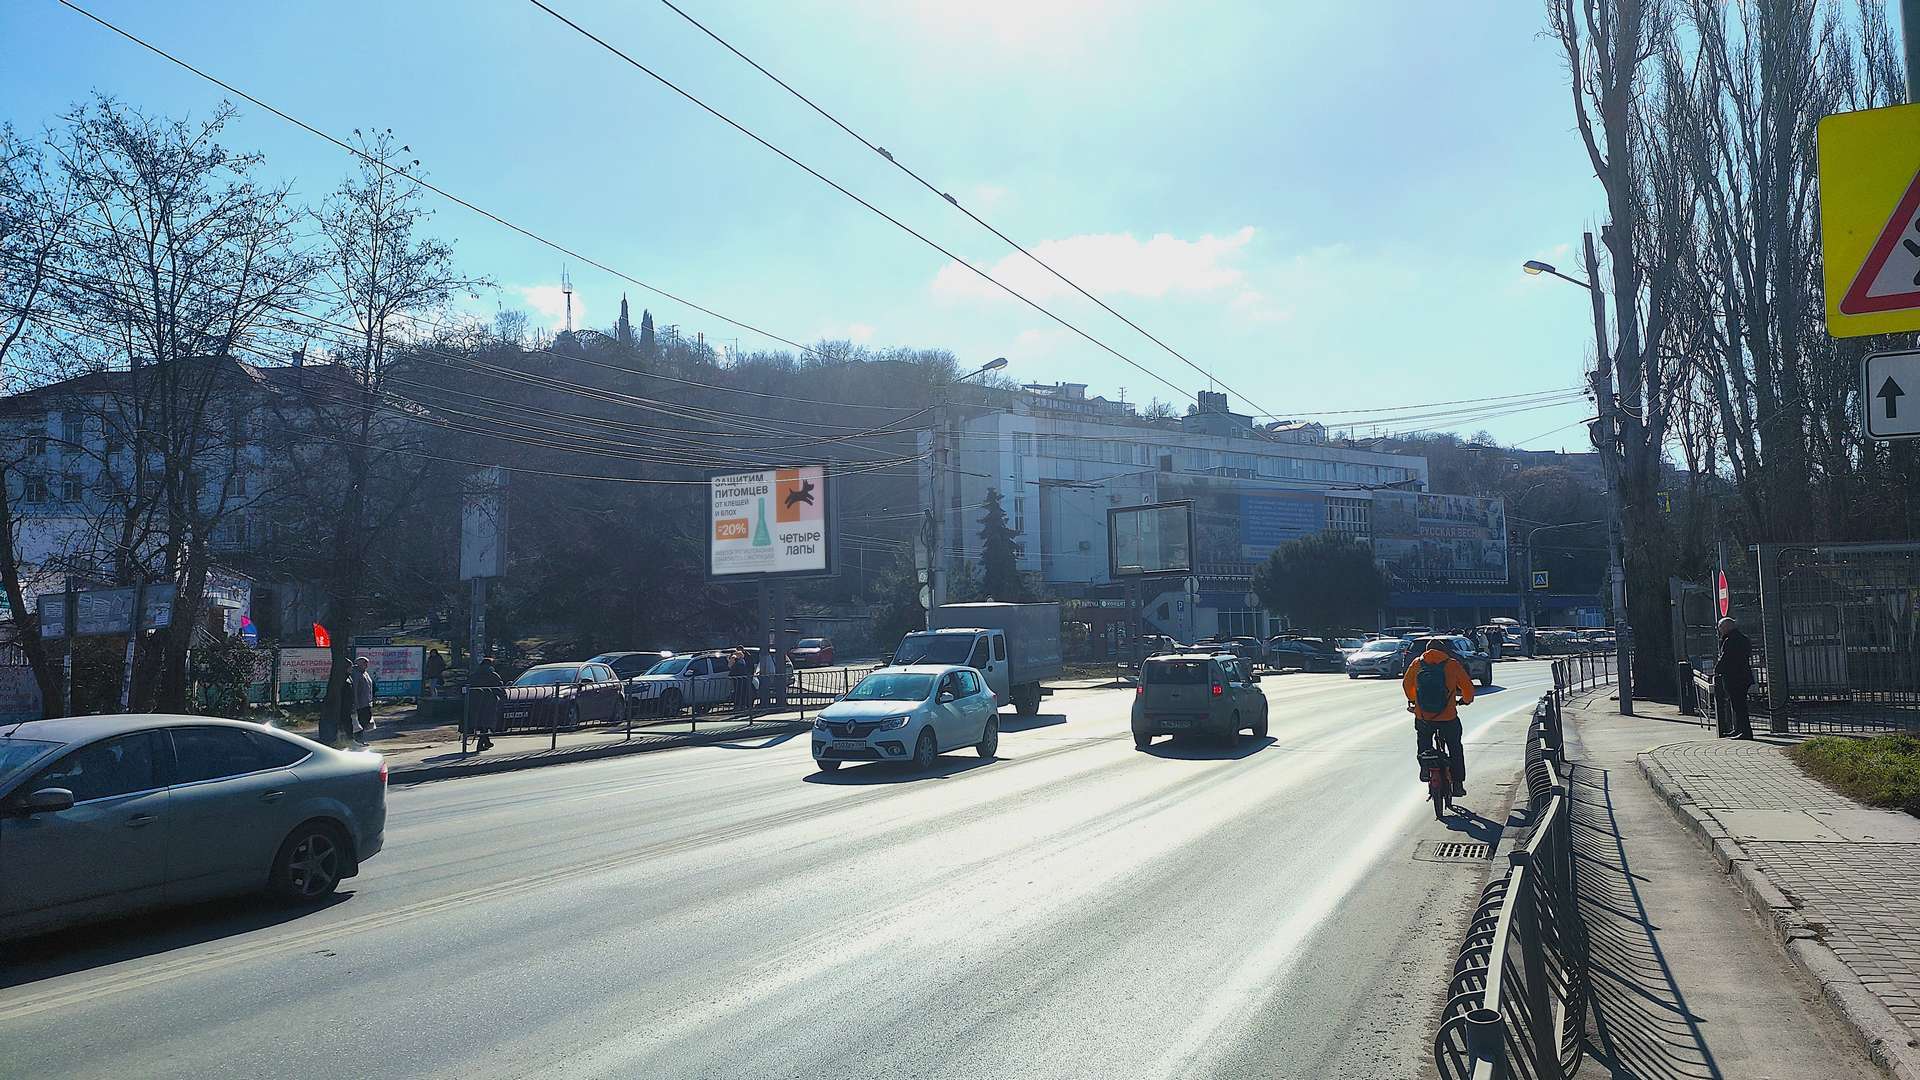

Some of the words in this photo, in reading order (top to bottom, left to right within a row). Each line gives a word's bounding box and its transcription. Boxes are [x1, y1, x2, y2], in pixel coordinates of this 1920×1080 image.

[715, 474, 764, 487] ЗАЩИТИМ
[715, 485, 769, 499] ПИТОМЦЕВ
[717, 523, 746, 537] -20%
[1420, 526, 1456, 537] РУССКАЯ
[779, 531, 821, 544] четыре
[785, 544, 815, 556] лапы
